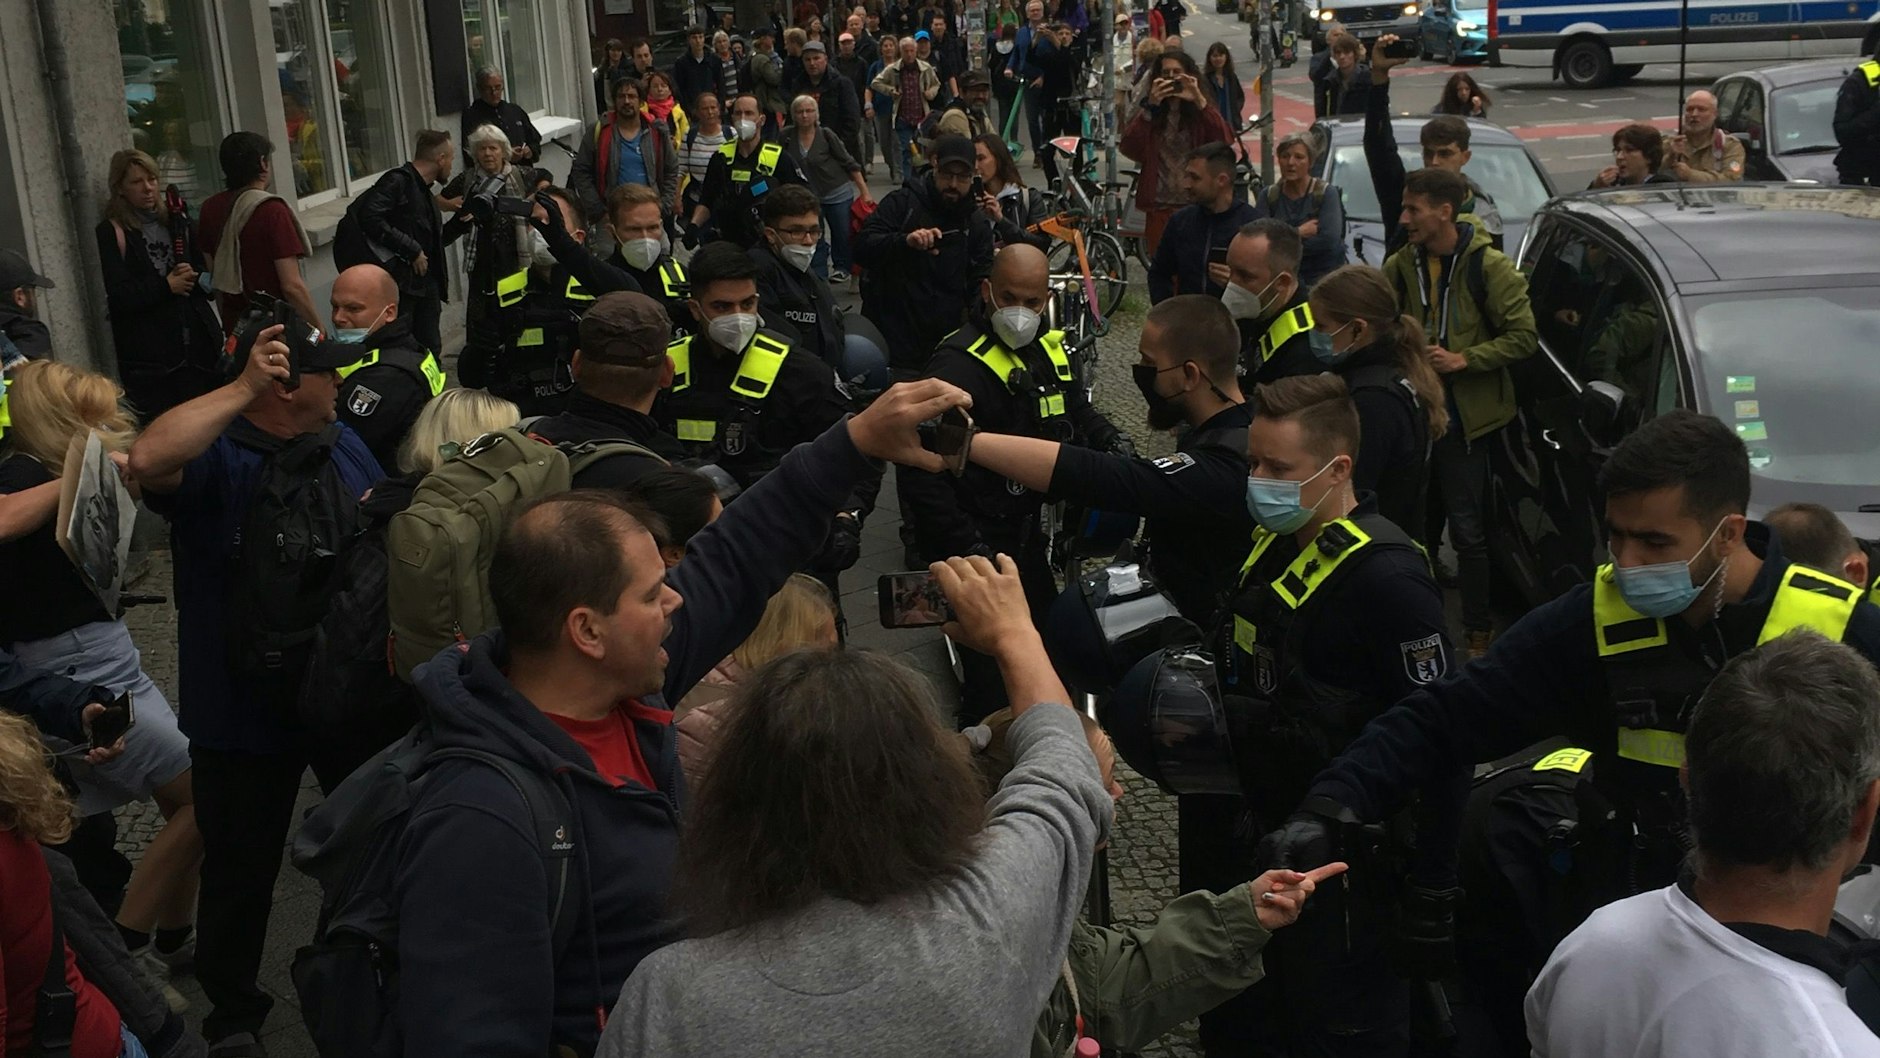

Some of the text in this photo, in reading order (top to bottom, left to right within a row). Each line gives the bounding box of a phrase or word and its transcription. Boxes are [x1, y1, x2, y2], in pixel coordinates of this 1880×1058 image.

[1710, 11, 1759, 24] POLIZEI
[784, 310, 817, 323] POLIZEI
[1404, 635, 1439, 653] POLIZEI
